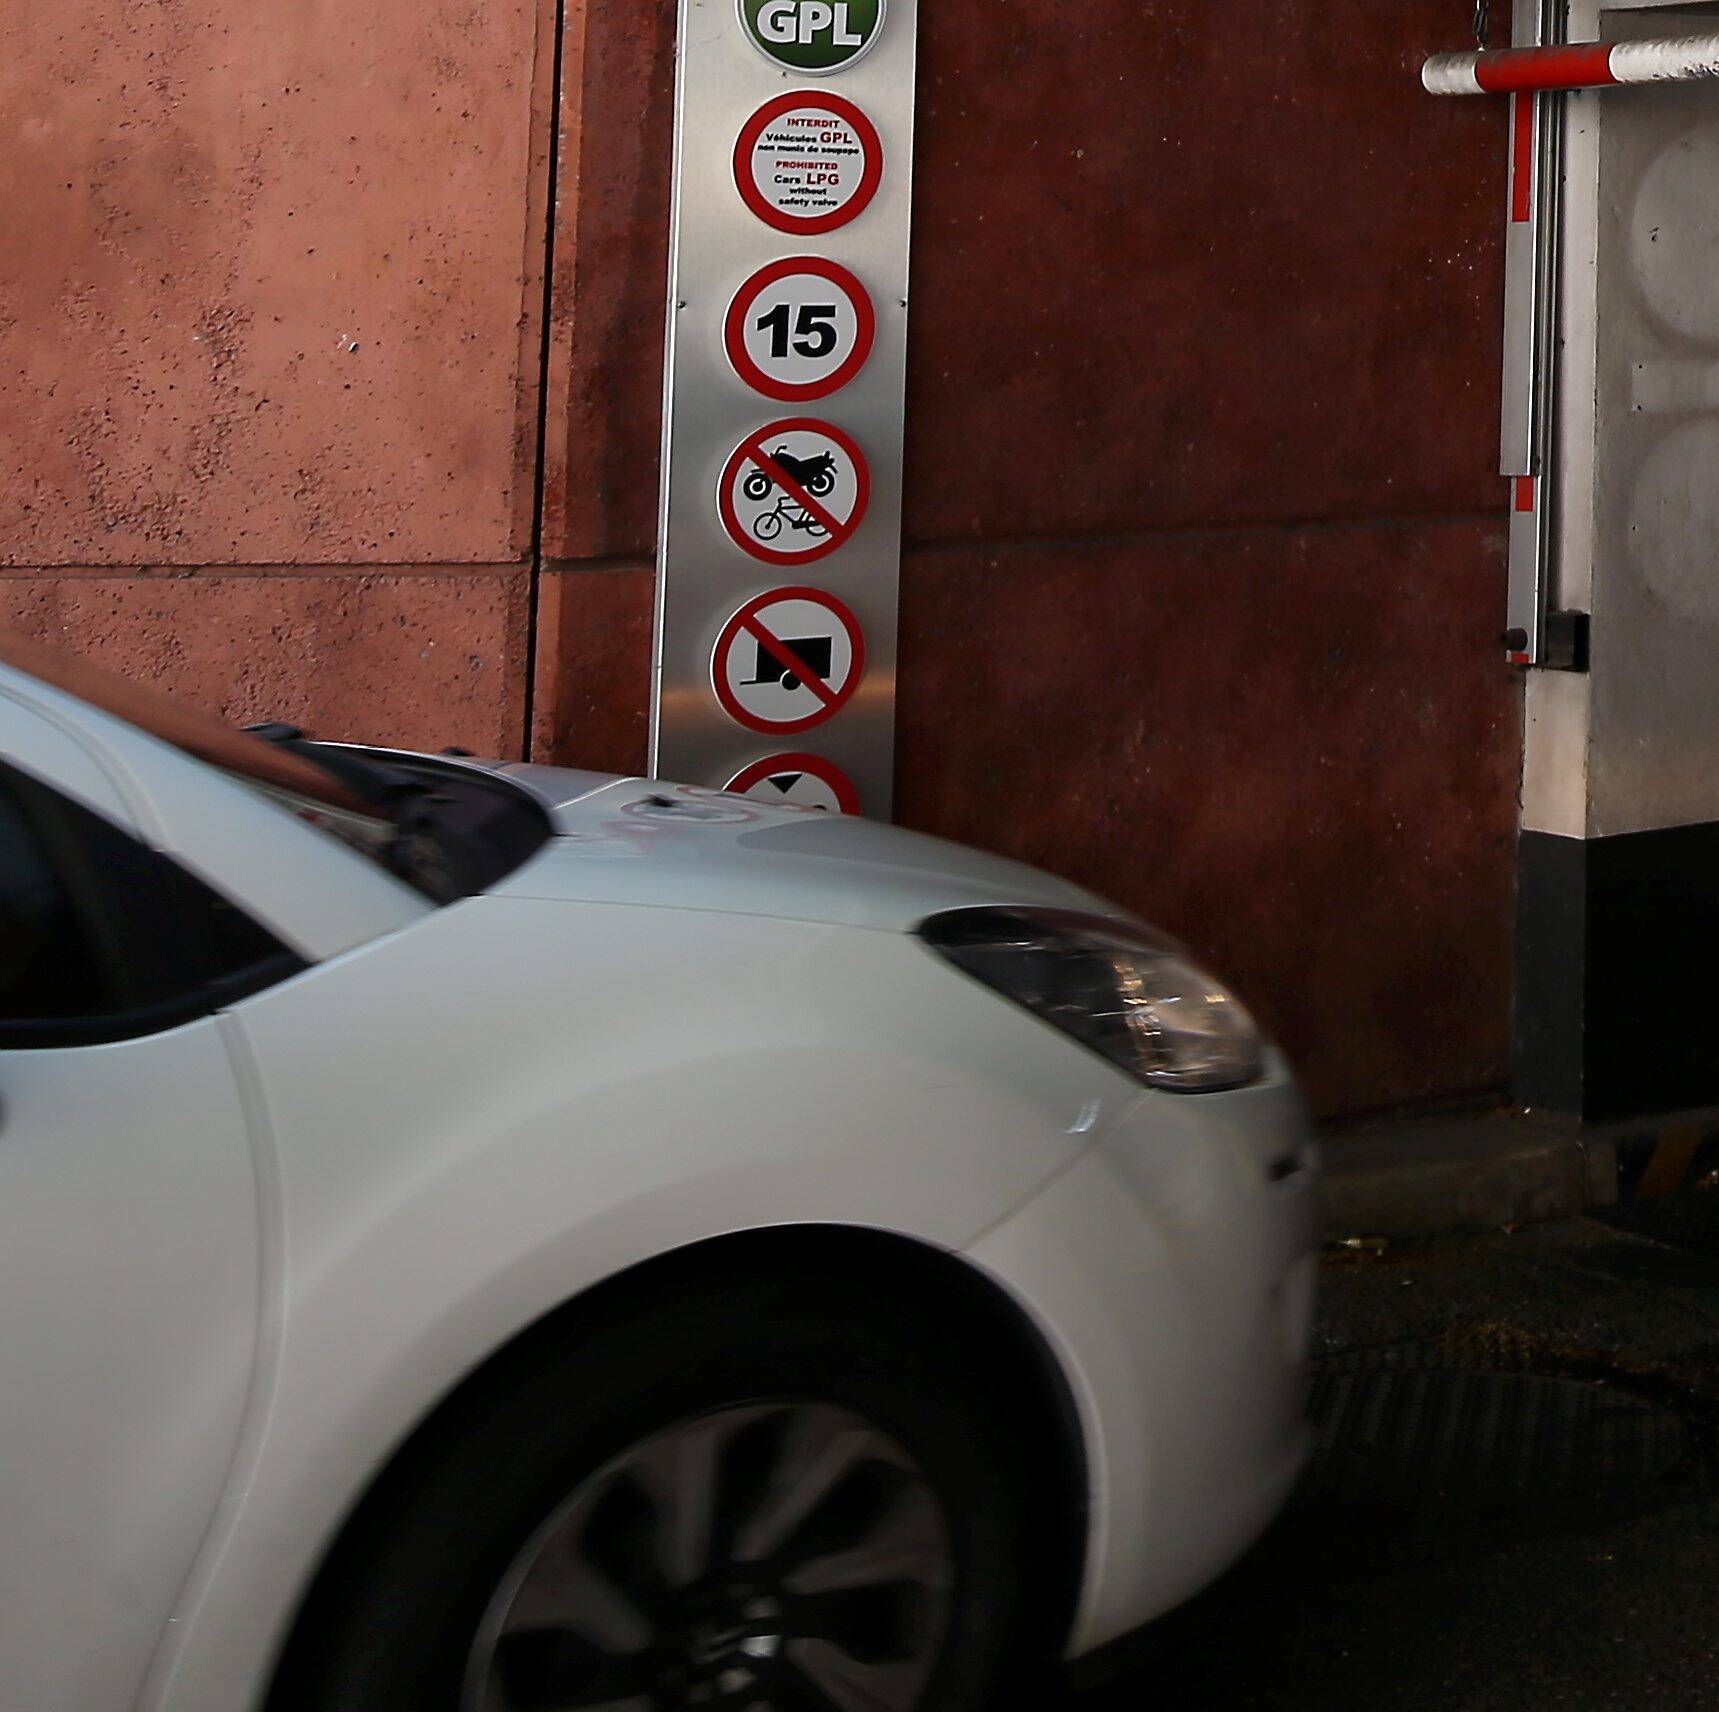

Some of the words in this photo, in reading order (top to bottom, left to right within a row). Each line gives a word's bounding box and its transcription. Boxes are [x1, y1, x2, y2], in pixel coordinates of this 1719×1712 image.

[757, 0, 862, 46] GPL
[787, 118, 840, 128] INTERDIT
[766, 133, 817, 143] Véhicules
[819, 131, 853, 144] GPL
[776, 160, 838, 170] PROHIBITED
[774, 174, 801, 184] Cars
[806, 173, 840, 185] LPG
[789, 187, 827, 195] without
[779, 198, 809, 207] safety
[755, 303, 838, 358] 15
